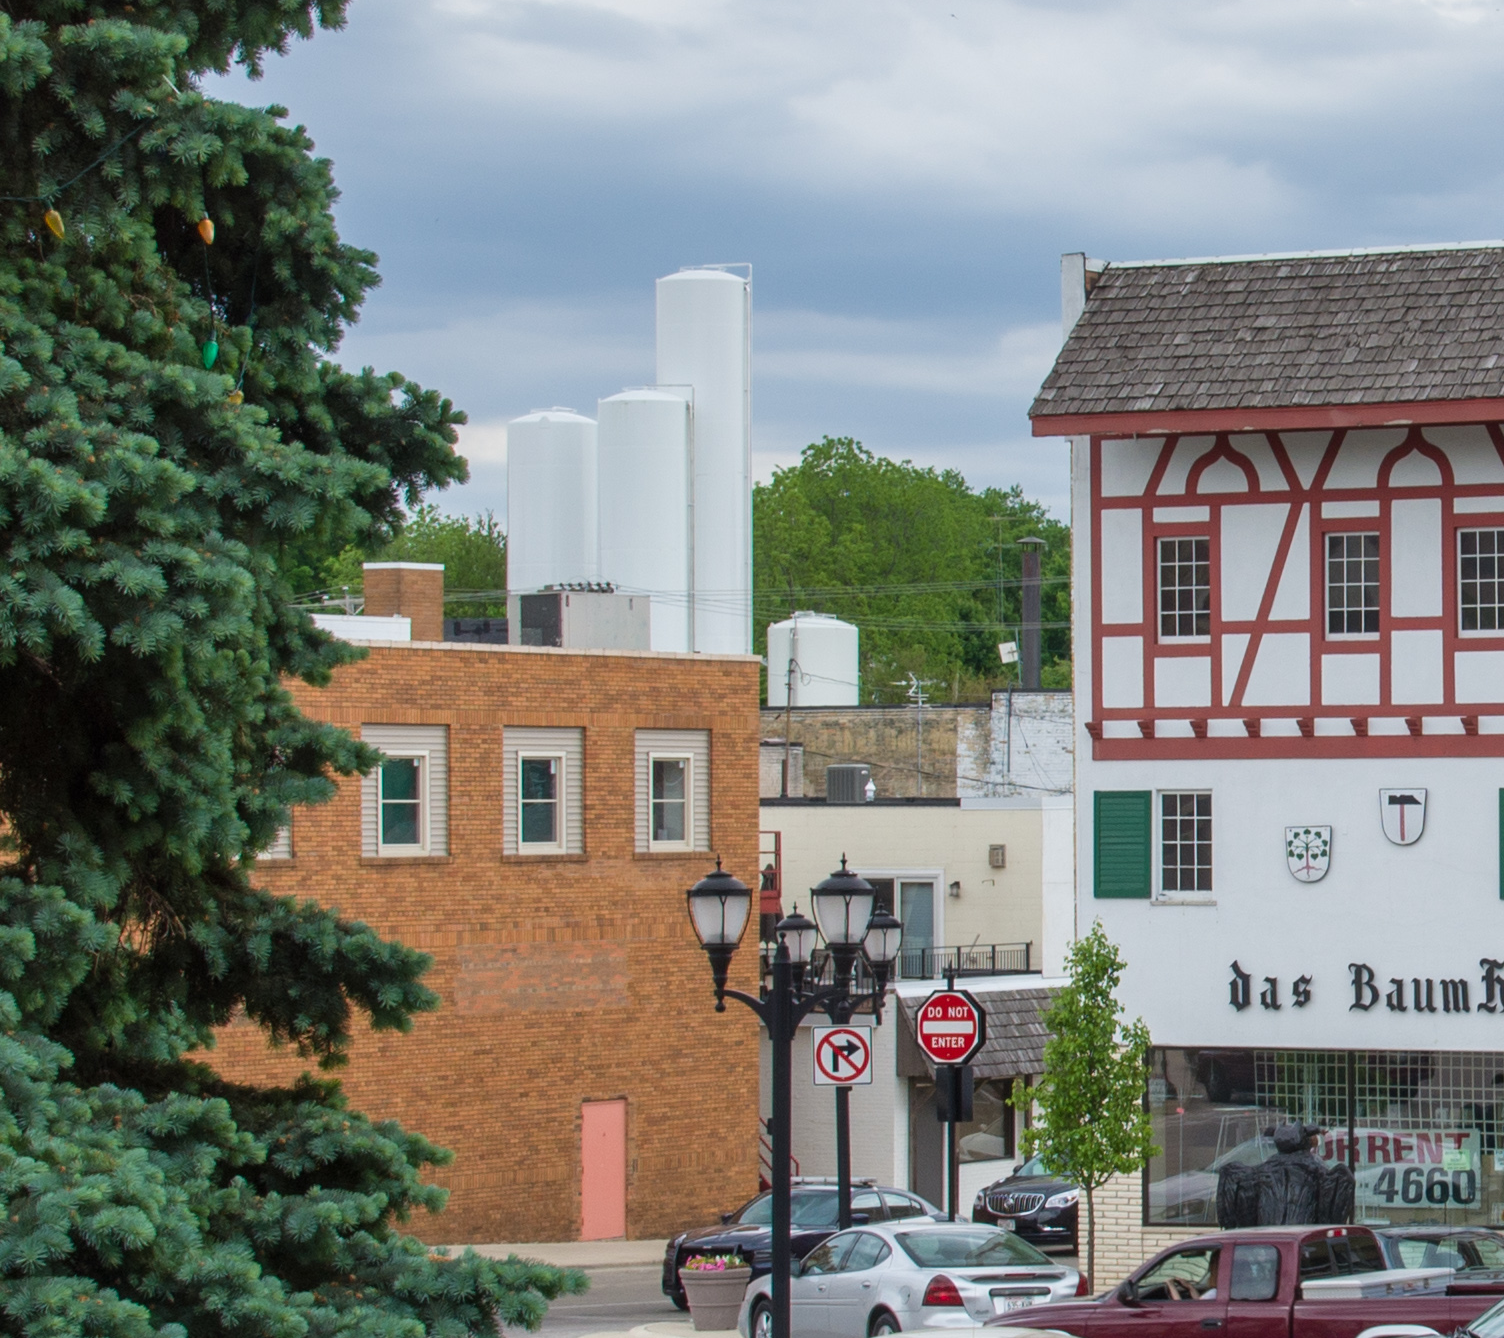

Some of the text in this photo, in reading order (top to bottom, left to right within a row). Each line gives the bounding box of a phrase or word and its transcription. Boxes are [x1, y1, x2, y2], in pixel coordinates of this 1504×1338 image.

[1228, 959, 1312, 1012] das
[927, 1006, 969, 1018] DO NOT
[931, 1036, 965, 1048] ENTER
[1367, 1132, 1470, 1164] RENT
